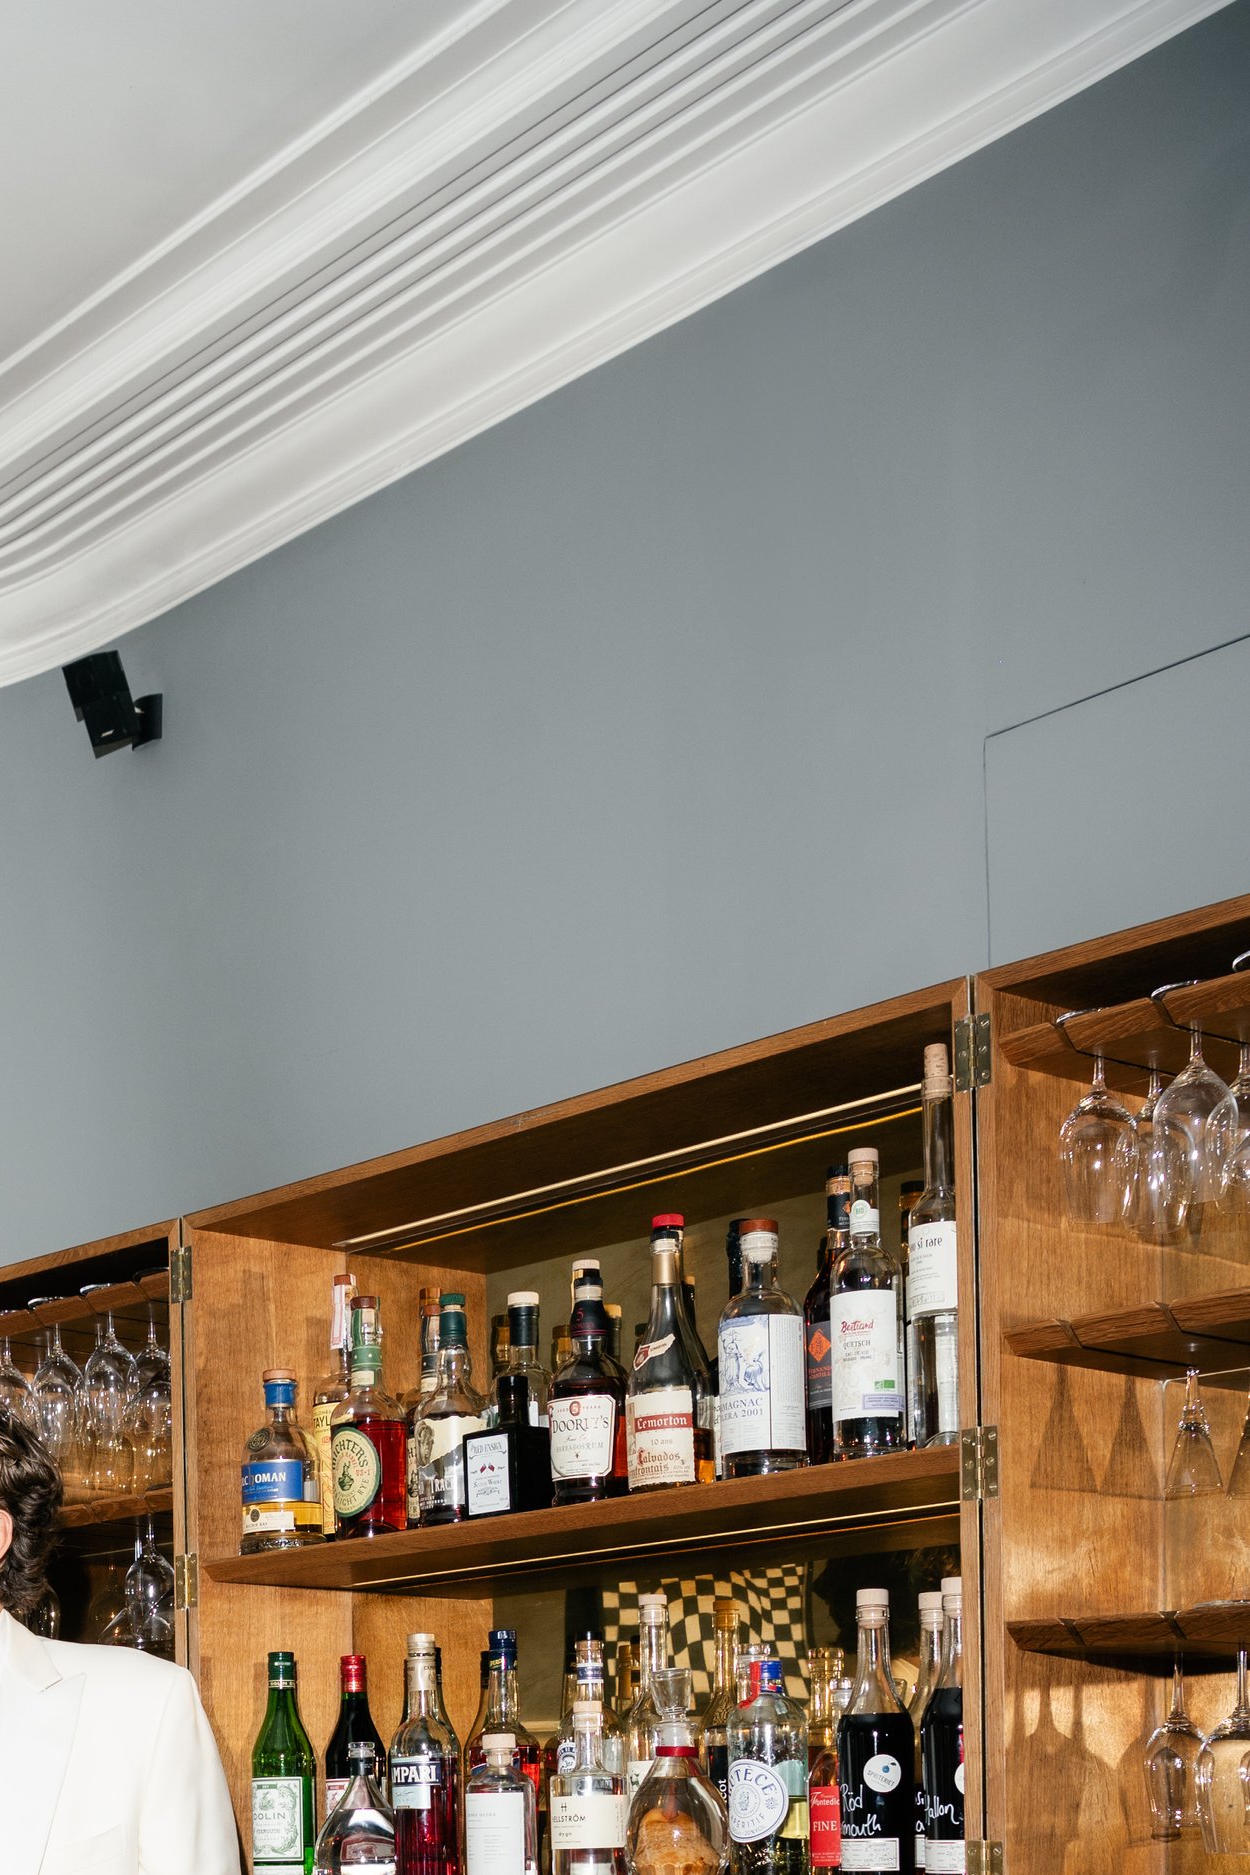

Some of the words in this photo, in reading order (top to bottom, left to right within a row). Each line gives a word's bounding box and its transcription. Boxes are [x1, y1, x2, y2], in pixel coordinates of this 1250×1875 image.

[741, 1408, 763, 1418] 2001
[552, 1415, 609, 1433] DOORLY'S
[637, 1415, 688, 1430] Lemorton
[637, 1447, 681, 1466] Calvados
[813, 1820, 838, 1832] FINE
